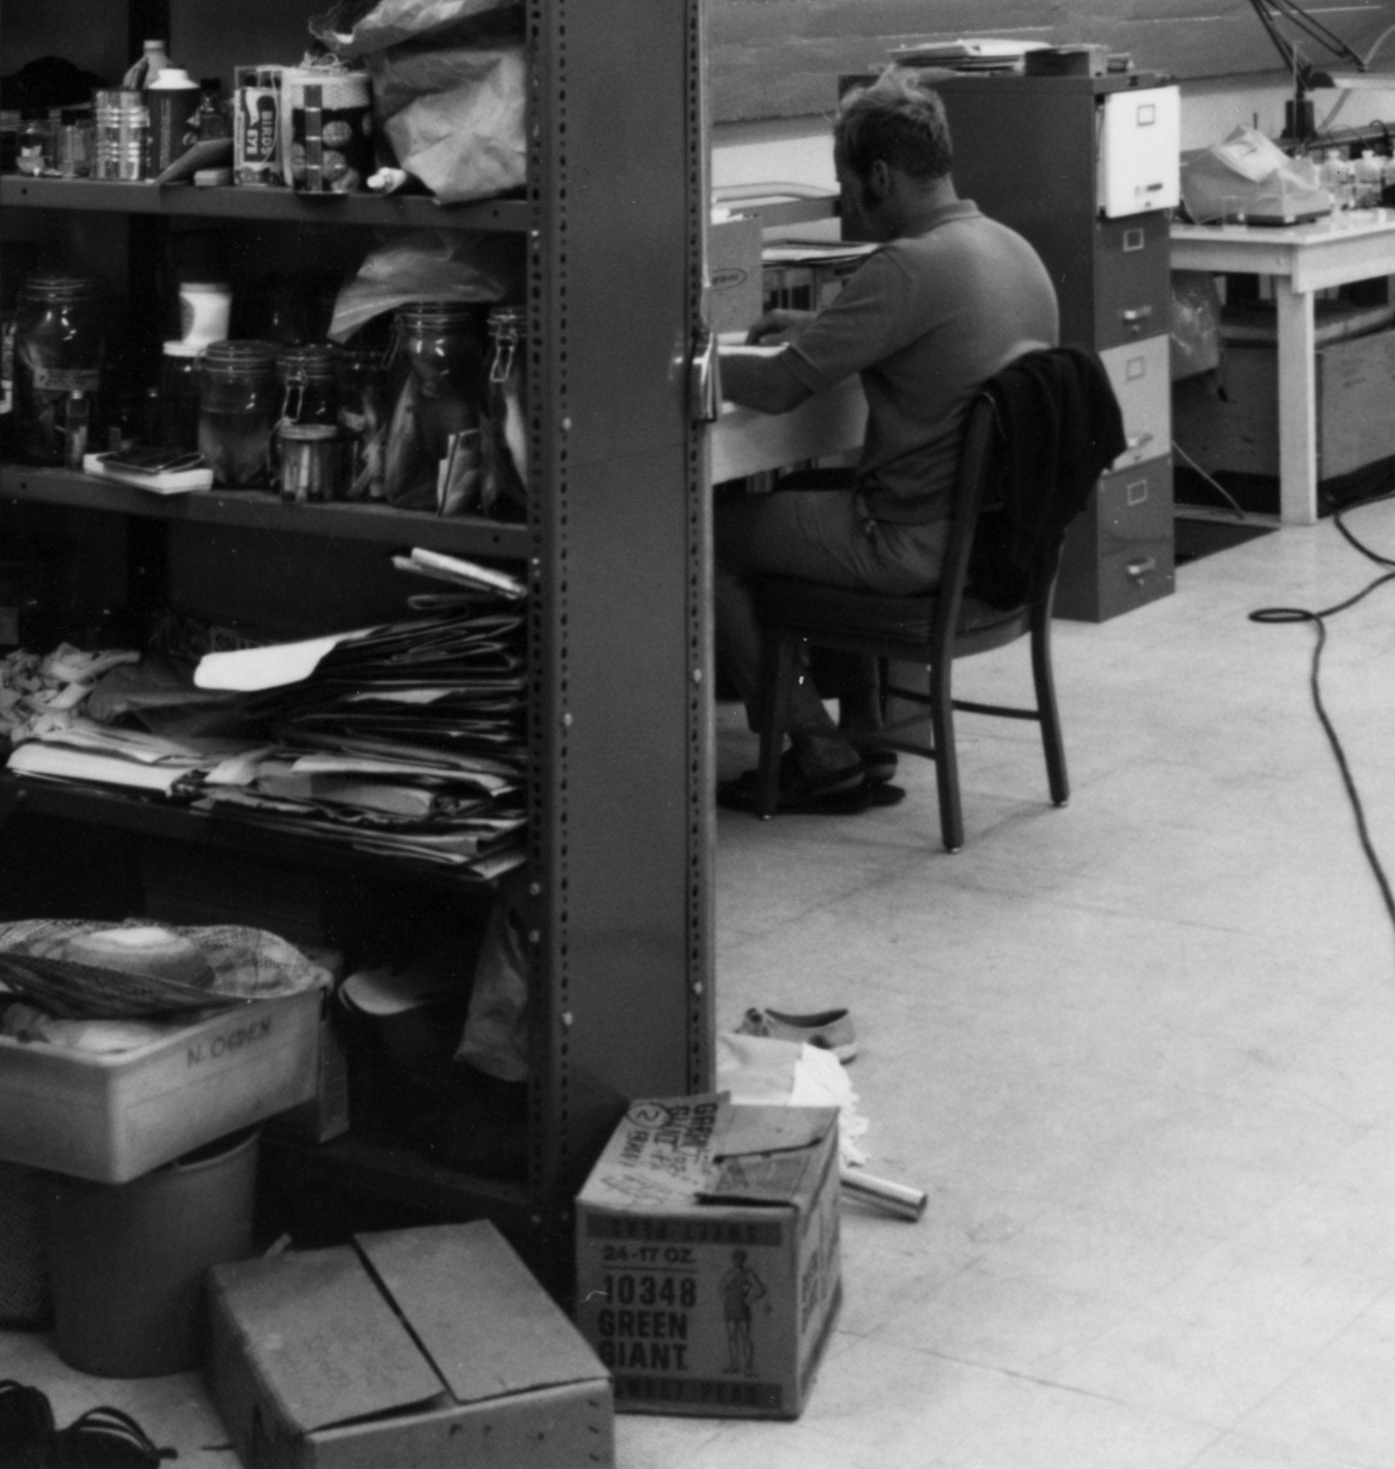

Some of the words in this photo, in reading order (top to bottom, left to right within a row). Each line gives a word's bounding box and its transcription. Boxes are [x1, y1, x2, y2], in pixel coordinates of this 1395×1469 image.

[246, 128, 258, 155] EYE
[260, 110, 274, 155] BIRDS
[604, 1245, 658, 1262] 24-17
[663, 1247, 698, 1264] OZ.
[603, 1274, 697, 1308] 10348
[599, 1309, 688, 1340] GREEN
